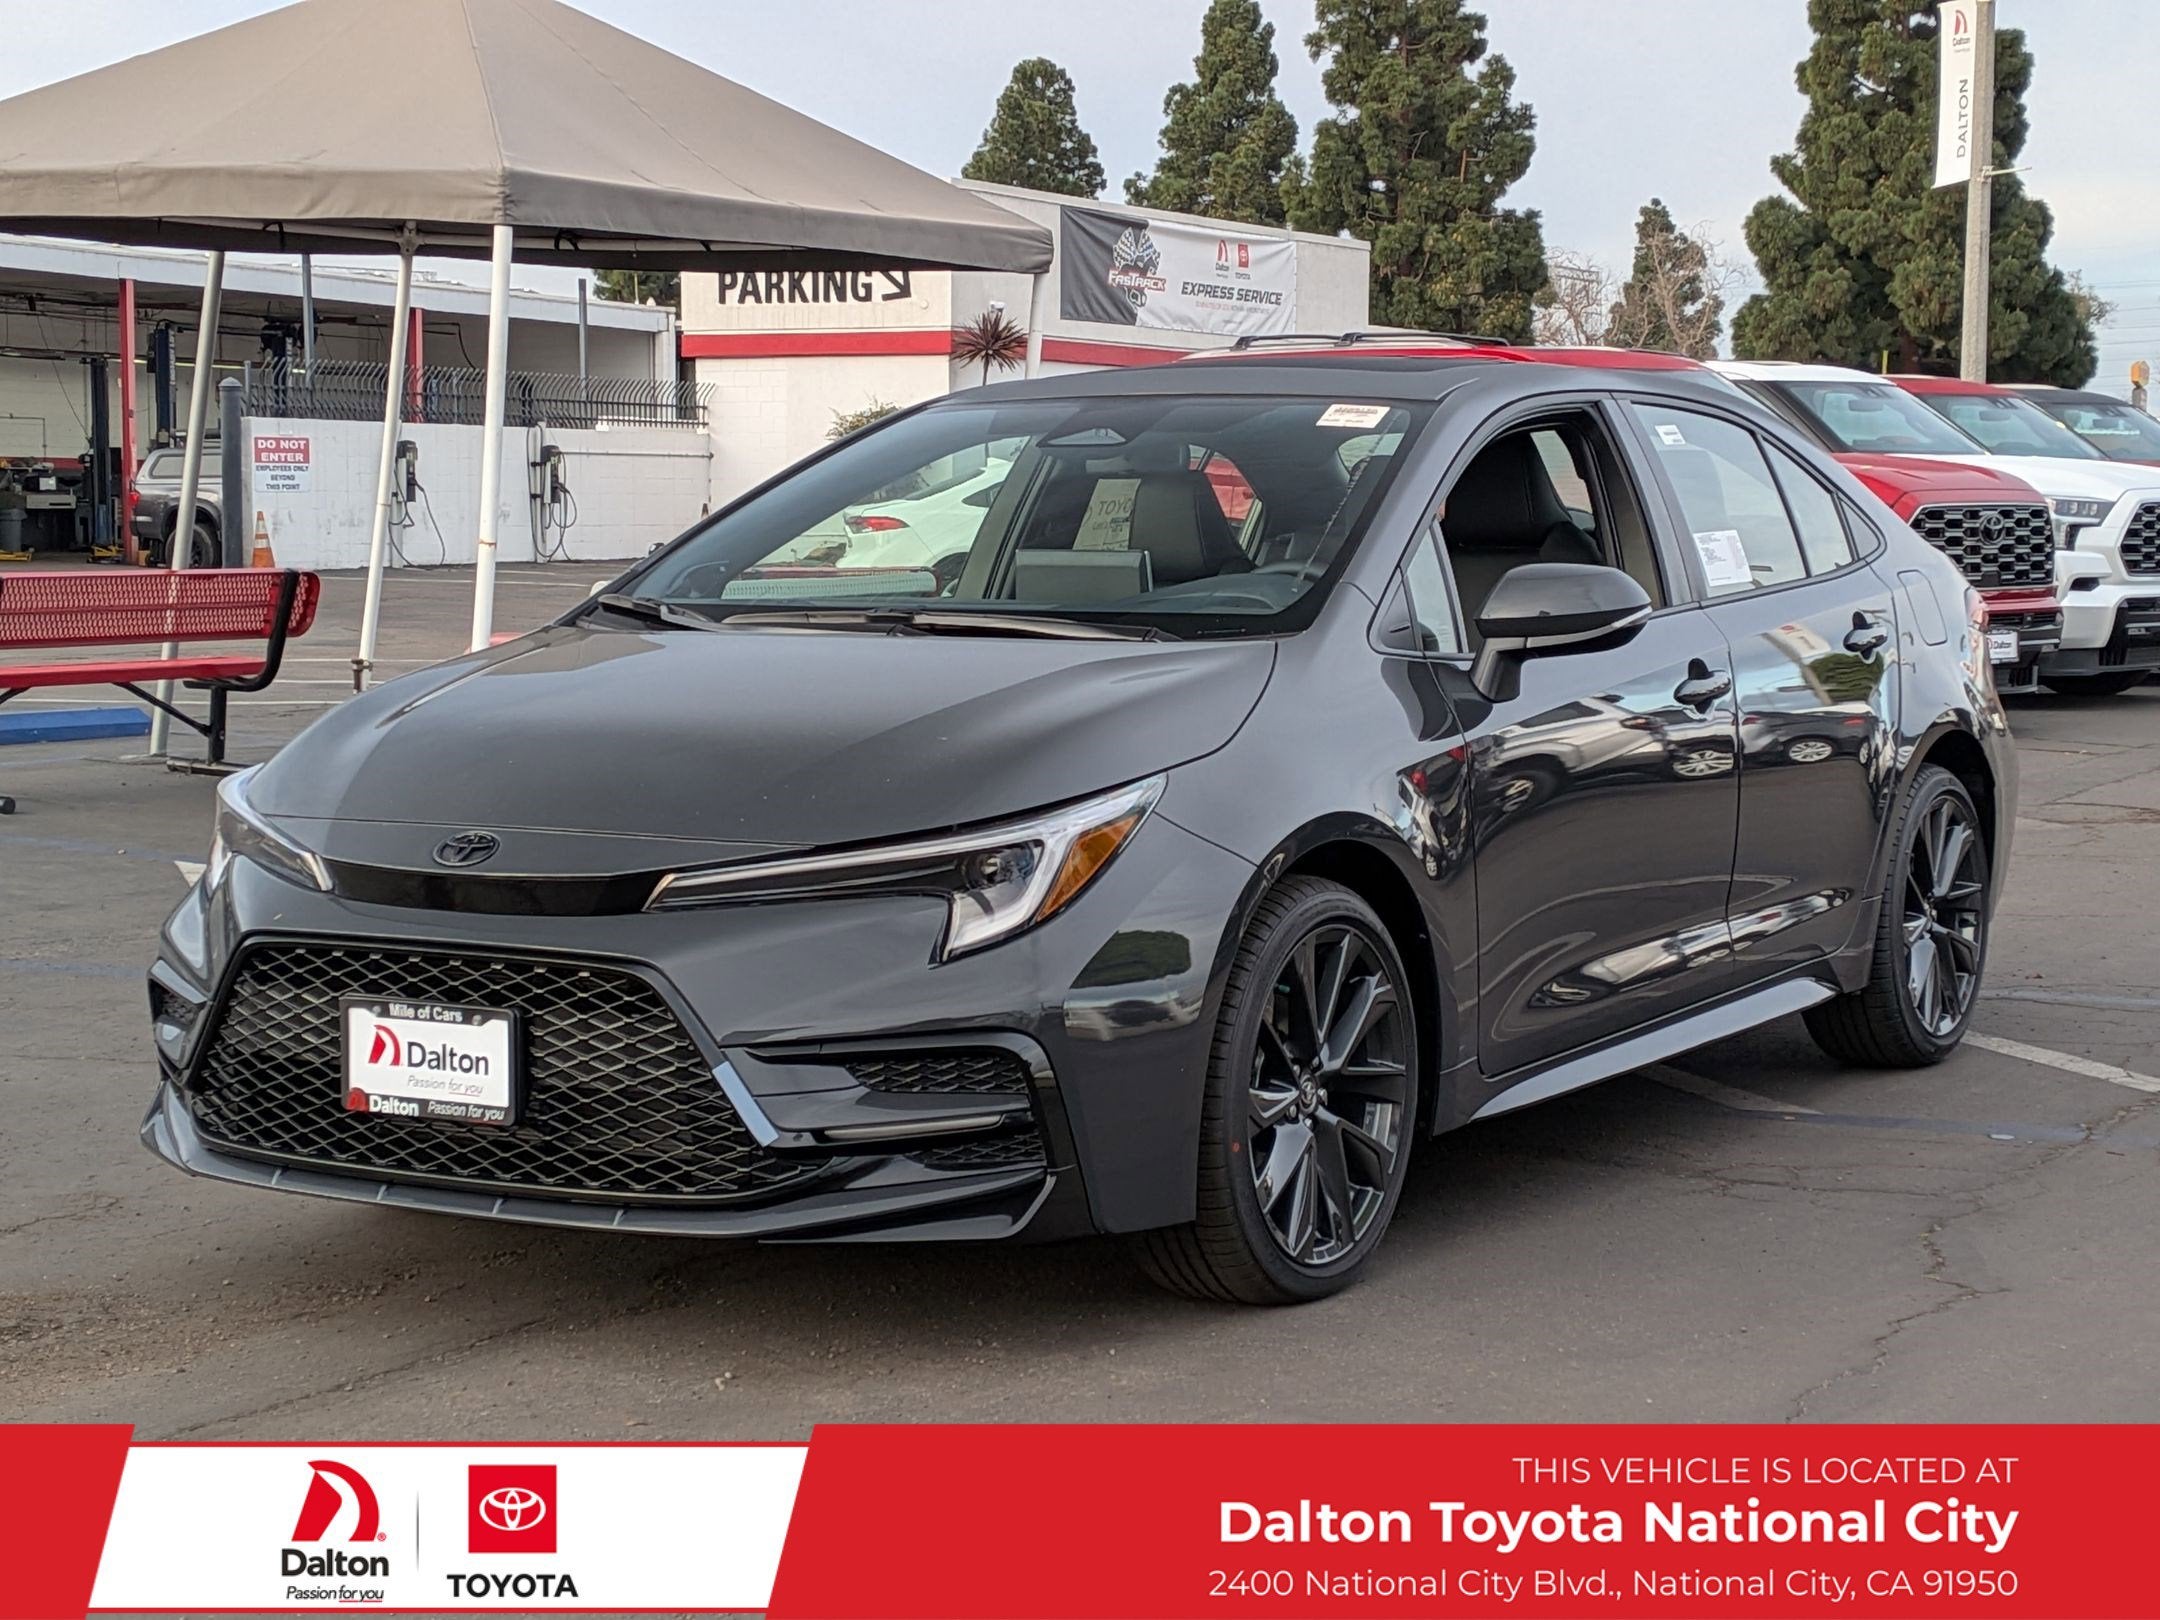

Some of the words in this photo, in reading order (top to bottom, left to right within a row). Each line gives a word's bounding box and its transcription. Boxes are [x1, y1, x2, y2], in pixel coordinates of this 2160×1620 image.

[1956, 79, 1969, 158] DALTON
[718, 271, 873, 304] PARKING
[1181, 281, 1235, 300] EXPRESS
[1236, 288, 1283, 306] SERVICE
[257, 439, 276, 449] DO
[280, 439, 307, 450] NOT
[261, 452, 304, 462] ENTER
[389, 1003, 415, 1019] Mile
[417, 1006, 430, 1019] of
[432, 1007, 463, 1022] Cars
[407, 1041, 489, 1076] Dalton
[407, 1075, 446, 1090] Passion
[448, 1078, 463, 1093] for
[464, 1082, 483, 1095] you
[369, 1095, 419, 1117] Dalton
[427, 1100, 466, 1117] Passion
[467, 1104, 484, 1119] for
[484, 1107, 505, 1121] you
